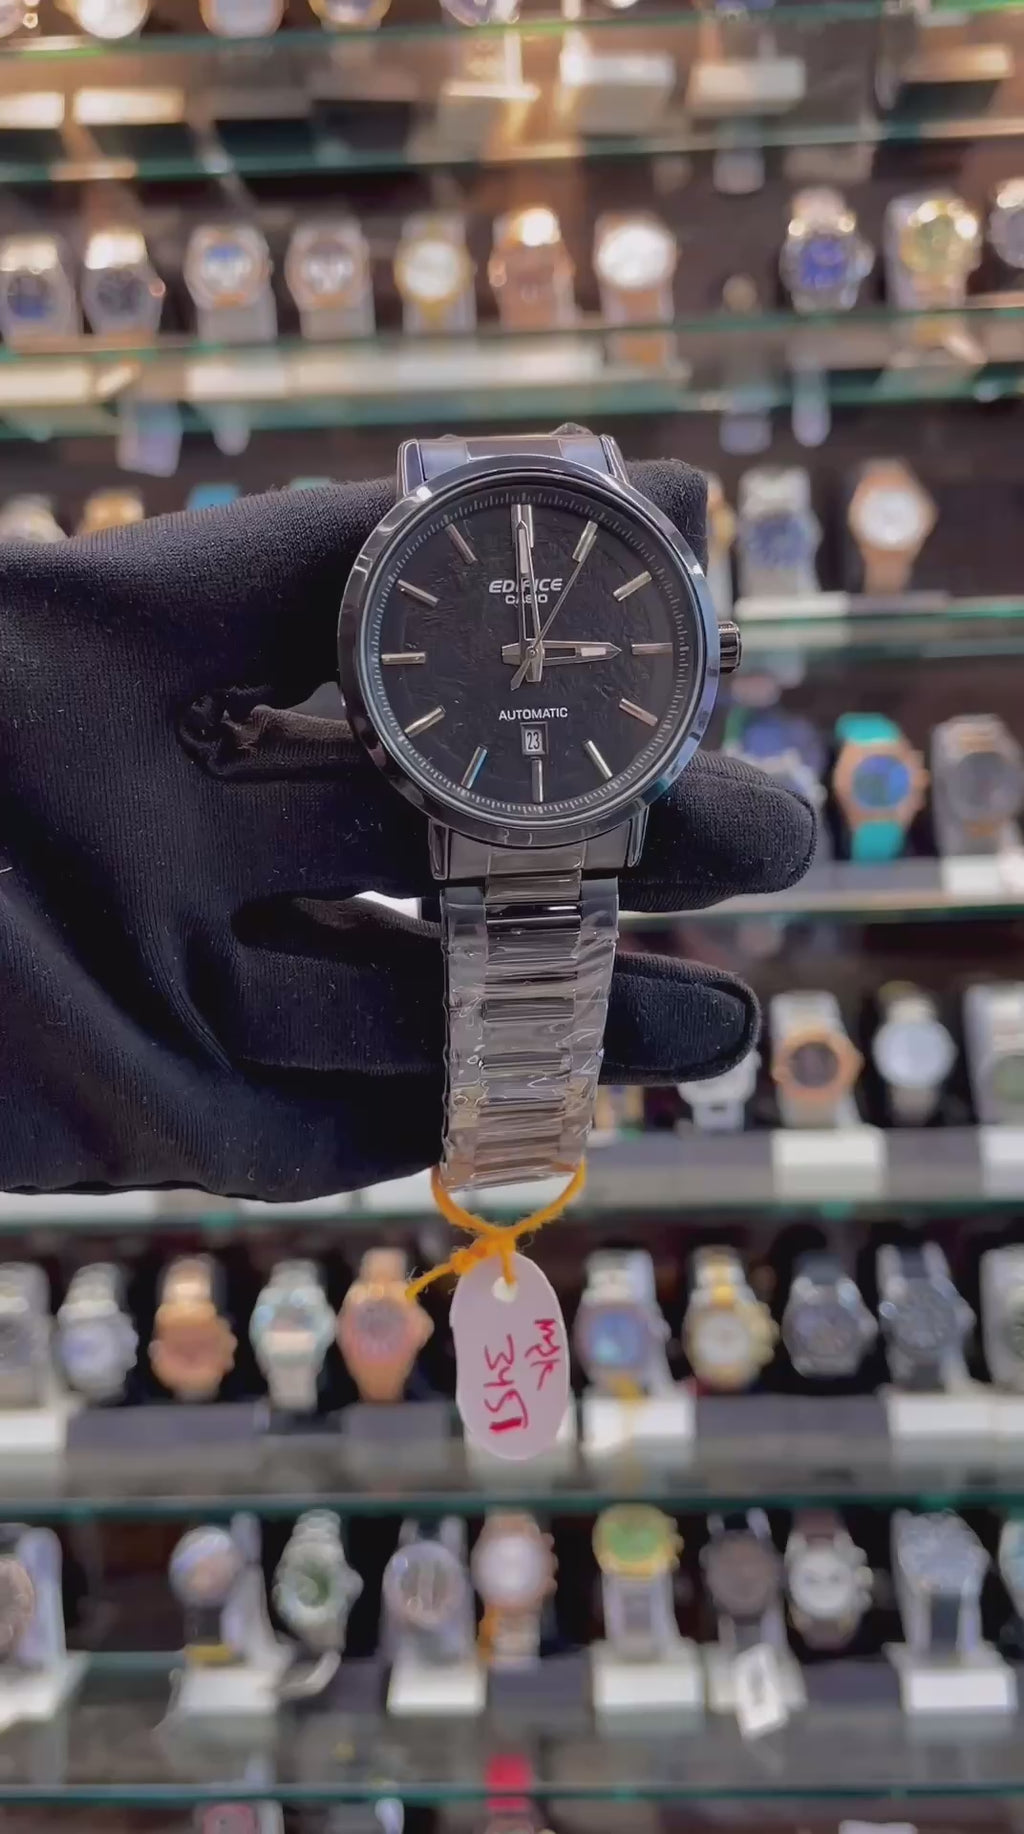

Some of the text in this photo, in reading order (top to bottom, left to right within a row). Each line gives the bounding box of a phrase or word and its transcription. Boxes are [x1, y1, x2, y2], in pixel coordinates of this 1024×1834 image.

[505, 593, 548, 605] CASO
[498, 707, 568, 721] AUTOMATIC
[526, 731, 540, 750] 23
[484, 1334, 528, 1432] 3451
